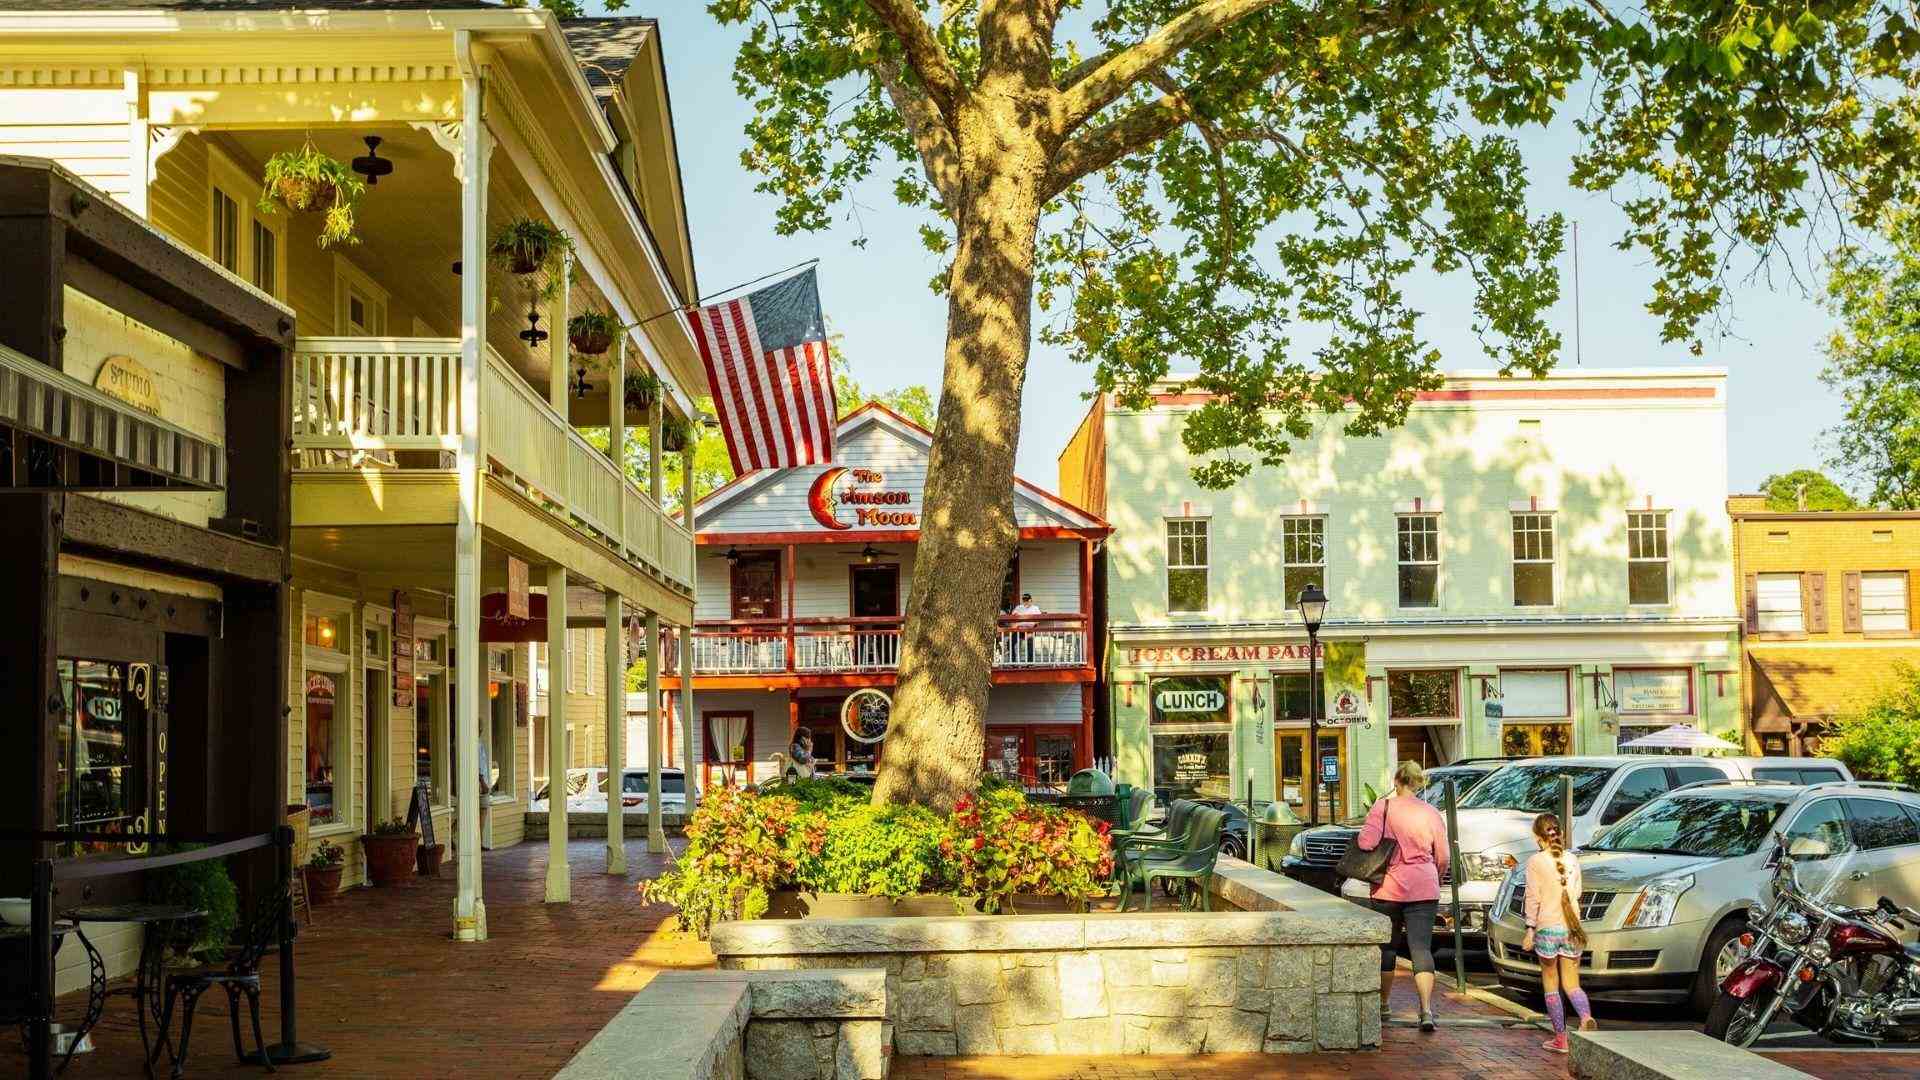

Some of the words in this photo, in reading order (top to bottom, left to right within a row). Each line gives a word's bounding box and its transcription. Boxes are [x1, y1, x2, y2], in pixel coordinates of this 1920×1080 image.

[110, 363, 151, 398] STUDIO
[852, 469, 882, 483] The
[856, 508, 917, 526] Moon
[1135, 649, 1173, 662] ICE
[1179, 646, 1260, 661] CREAM
[1162, 692, 1218, 709] LUNCH
[1327, 717, 1369, 725] OCTOBER
[159, 732, 168, 834] OPEN
